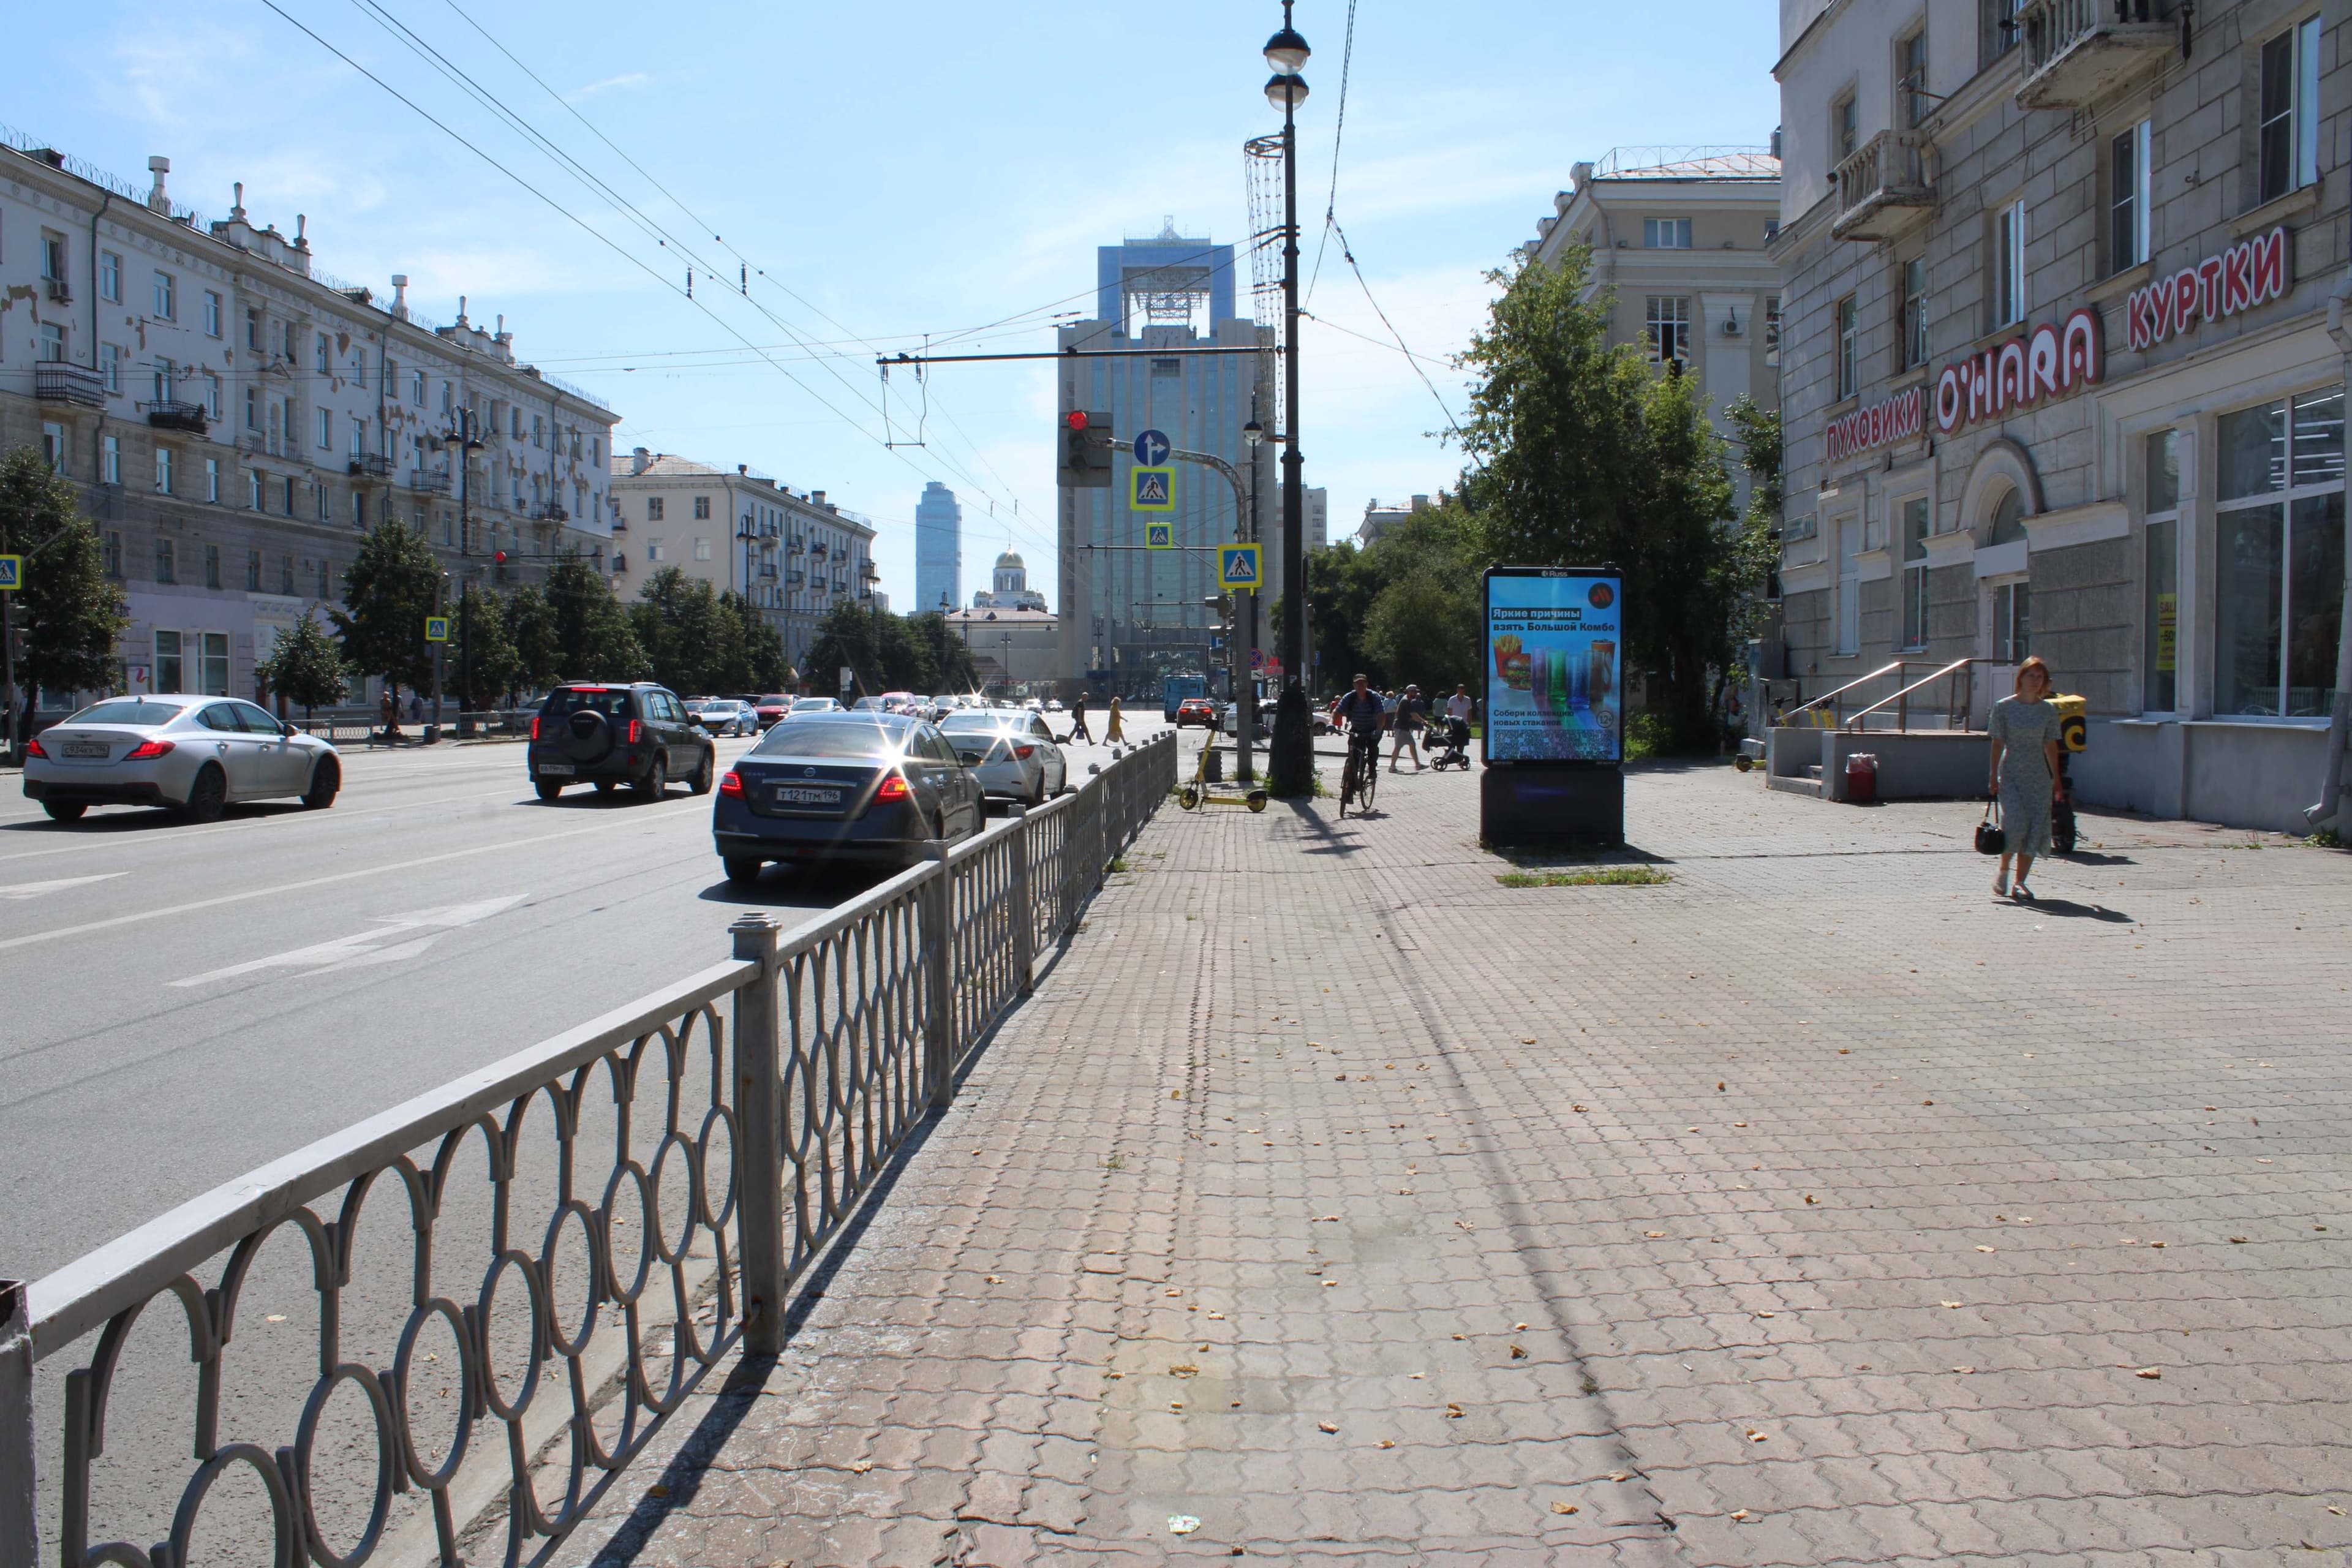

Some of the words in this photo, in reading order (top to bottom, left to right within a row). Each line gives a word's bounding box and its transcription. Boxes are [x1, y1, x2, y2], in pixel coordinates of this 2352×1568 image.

[2127, 225, 2290, 353] КУРТКИ
[1826, 386, 1921, 461] ПУХОВИКИ
[1493, 609, 1528, 619] Яркие
[1531, 609, 1580, 619] причины
[1527, 622, 1577, 631] Большой
[1580, 622, 1615, 631] Комбо
[1493, 709, 1525, 718] Собери
[1599, 715, 1612, 724] 12+
[780, 790, 821, 801] Т121ТМ
